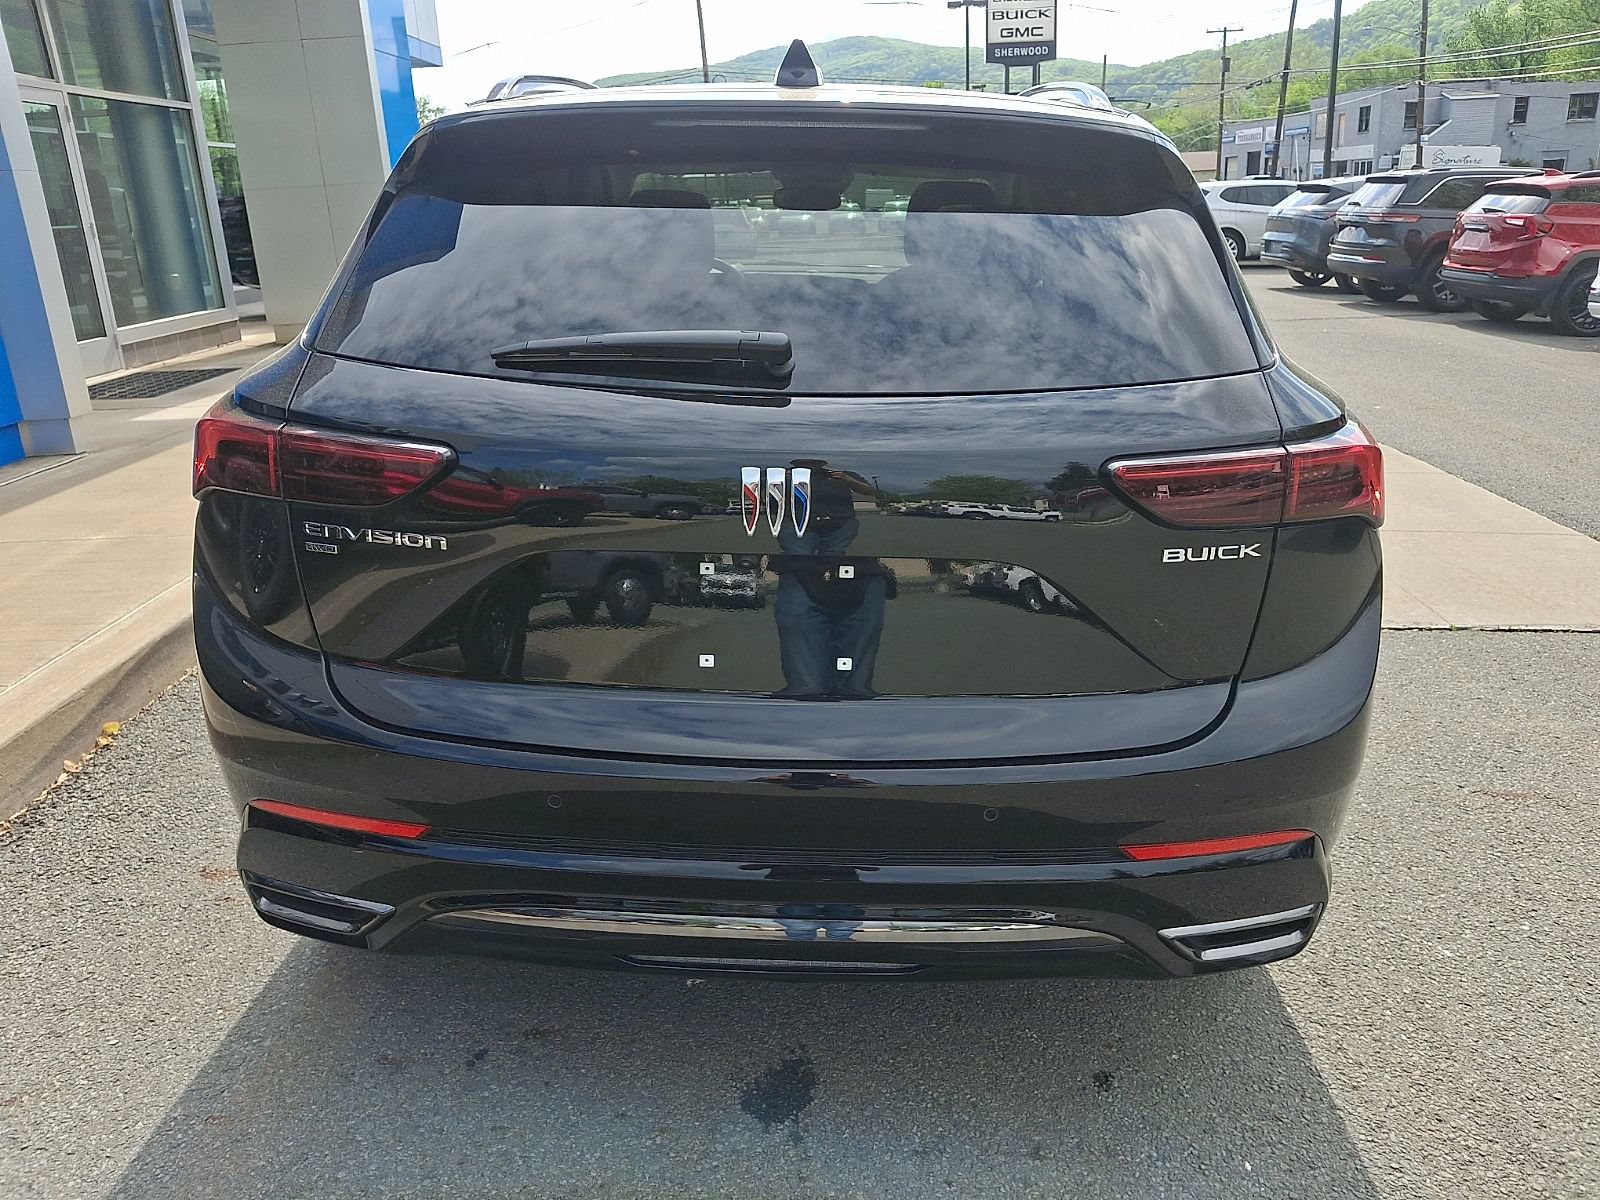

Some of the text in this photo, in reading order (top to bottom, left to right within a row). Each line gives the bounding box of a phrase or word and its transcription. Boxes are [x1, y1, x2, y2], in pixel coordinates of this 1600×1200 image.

[992, 9, 1051, 20] BUICK
[1000, 26, 1043, 38] GMC
[994, 46, 1049, 57] SHERWOOD
[1431, 151, 1482, 166] Signature
[1162, 543, 1262, 563] BUICK
